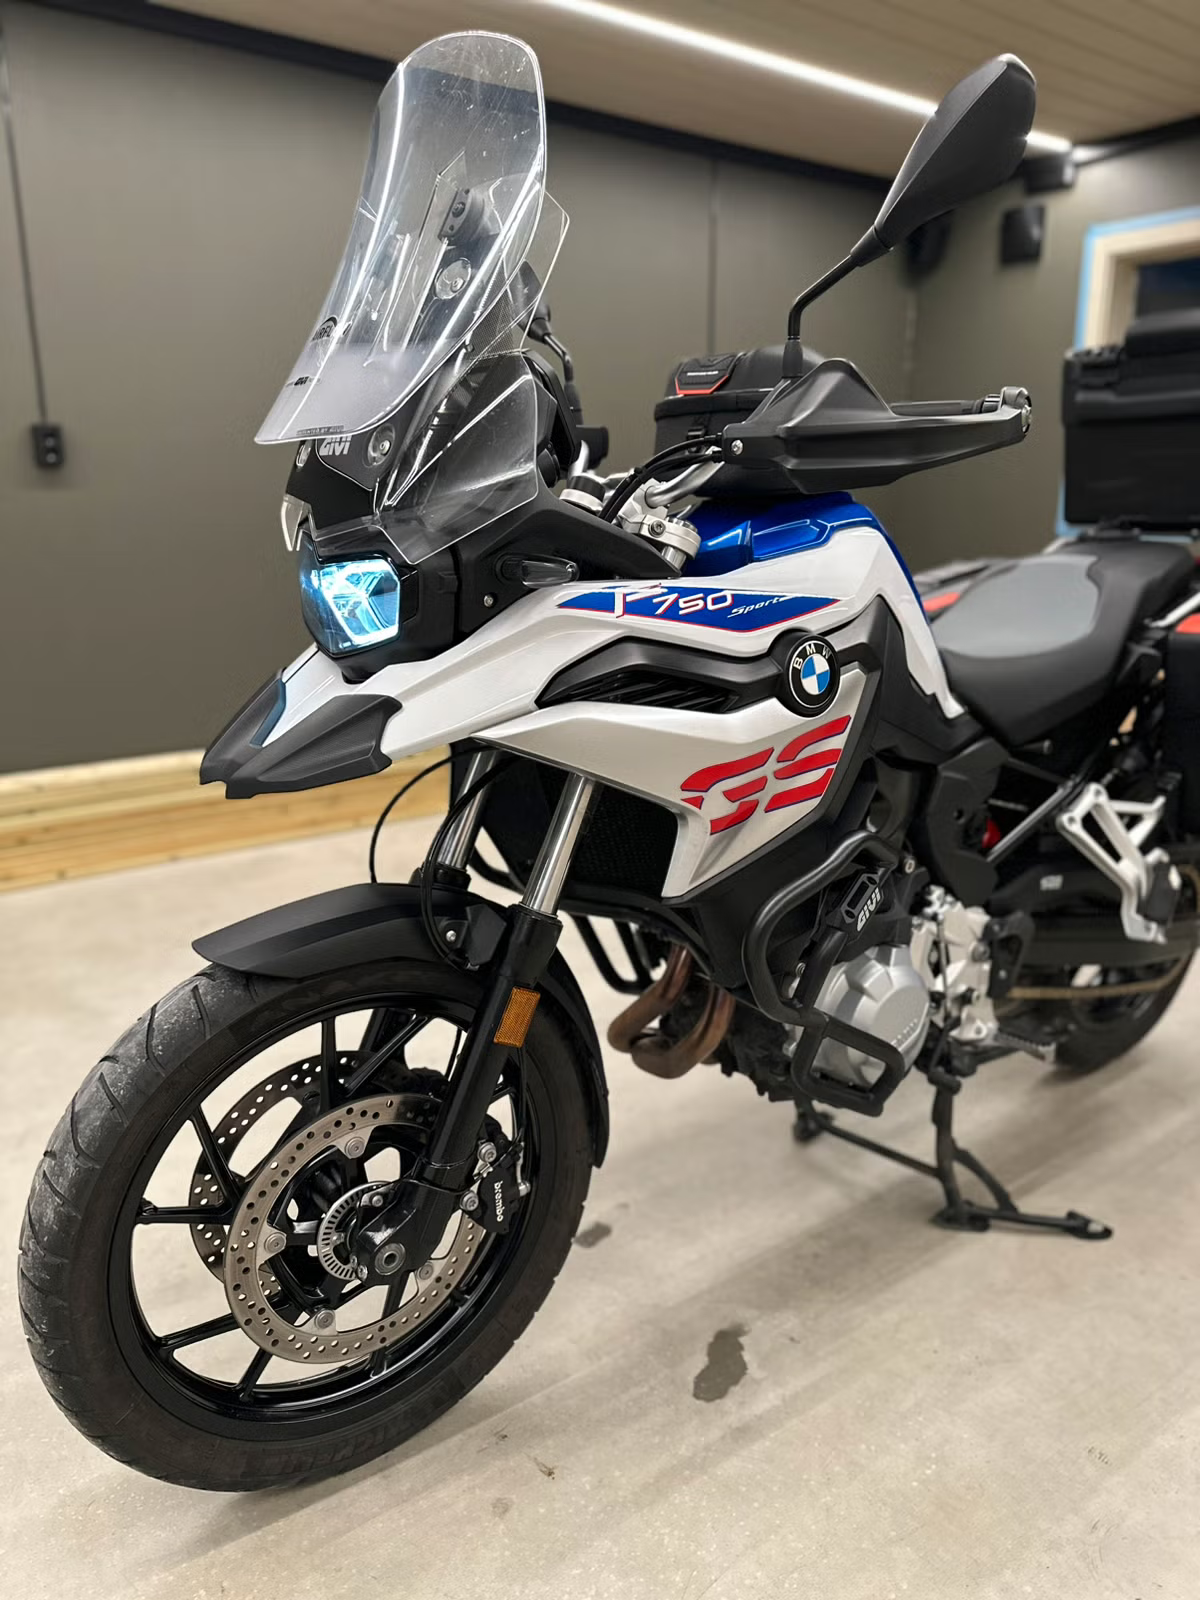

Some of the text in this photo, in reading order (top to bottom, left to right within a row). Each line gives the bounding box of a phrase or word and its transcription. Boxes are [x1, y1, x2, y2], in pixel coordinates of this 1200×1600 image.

[319, 435, 353, 457] GIVI
[652, 590, 735, 616] 750
[727, 596, 792, 618] Sport
[792, 642, 832, 670] BMW
[680, 715, 852, 836] GS
[856, 887, 882, 932] GIVI
[494, 1180, 506, 1222] brembo
